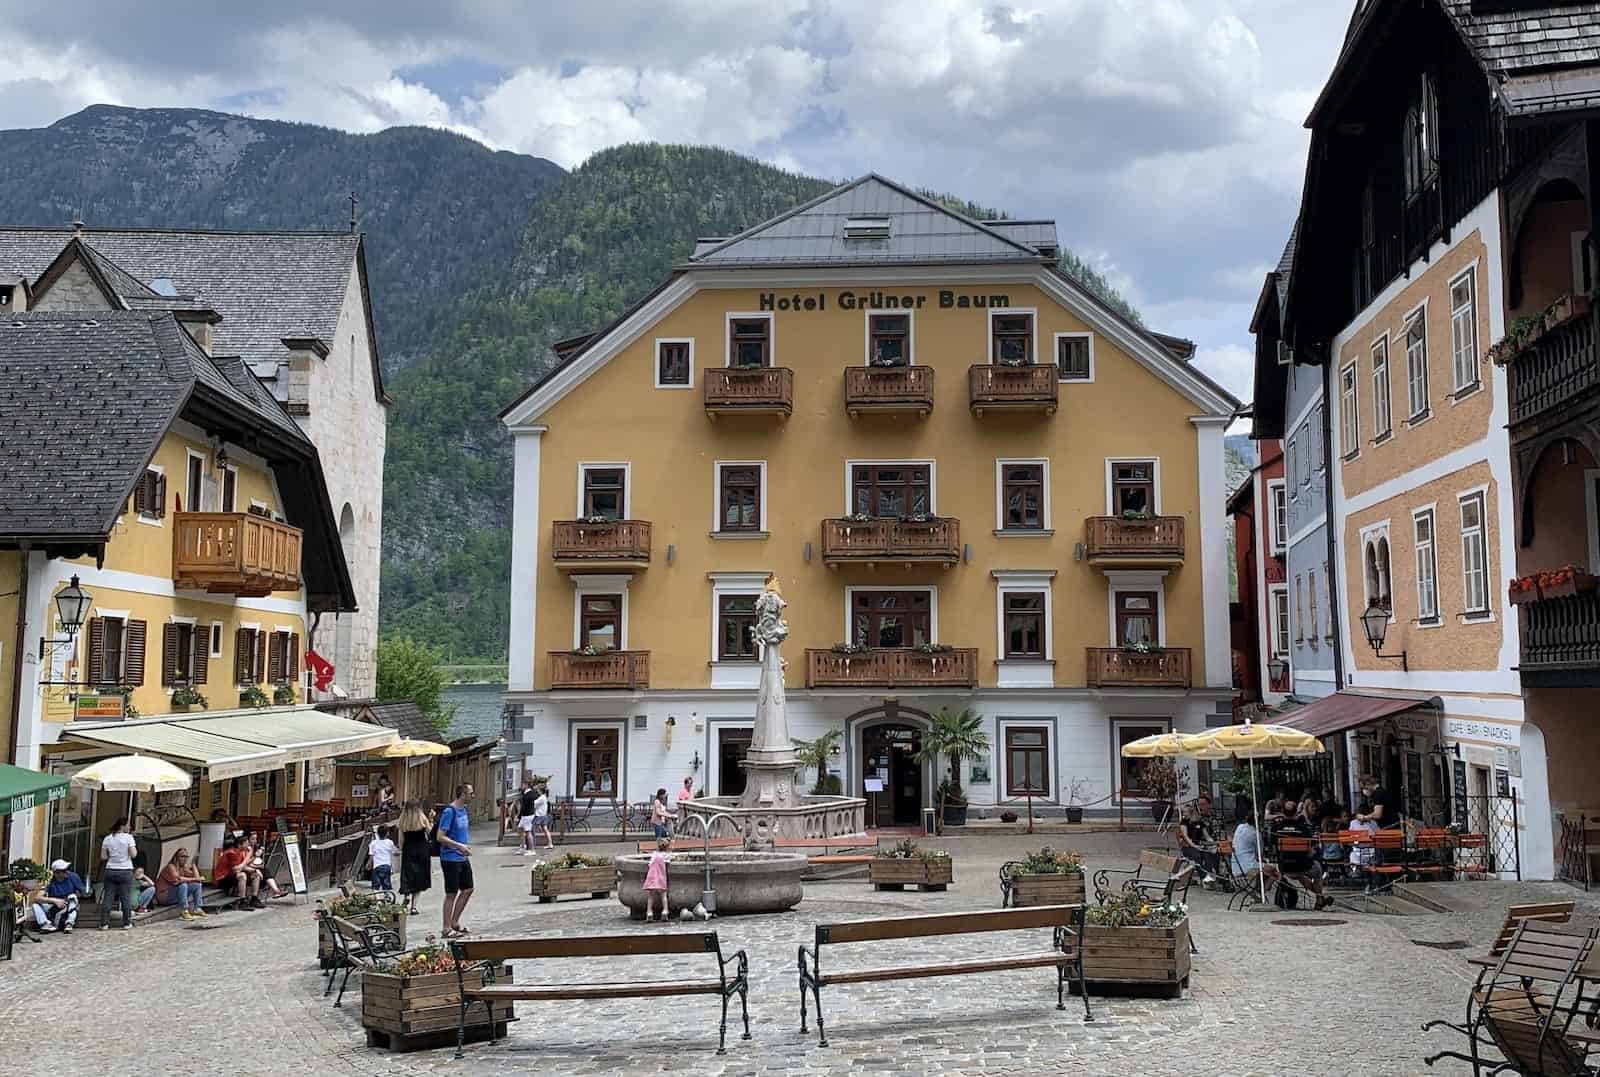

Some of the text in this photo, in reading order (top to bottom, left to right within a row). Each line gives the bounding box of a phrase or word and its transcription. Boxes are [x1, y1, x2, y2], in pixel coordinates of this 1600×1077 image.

[759, 290, 1010, 311] Hotel Grüner Baum
